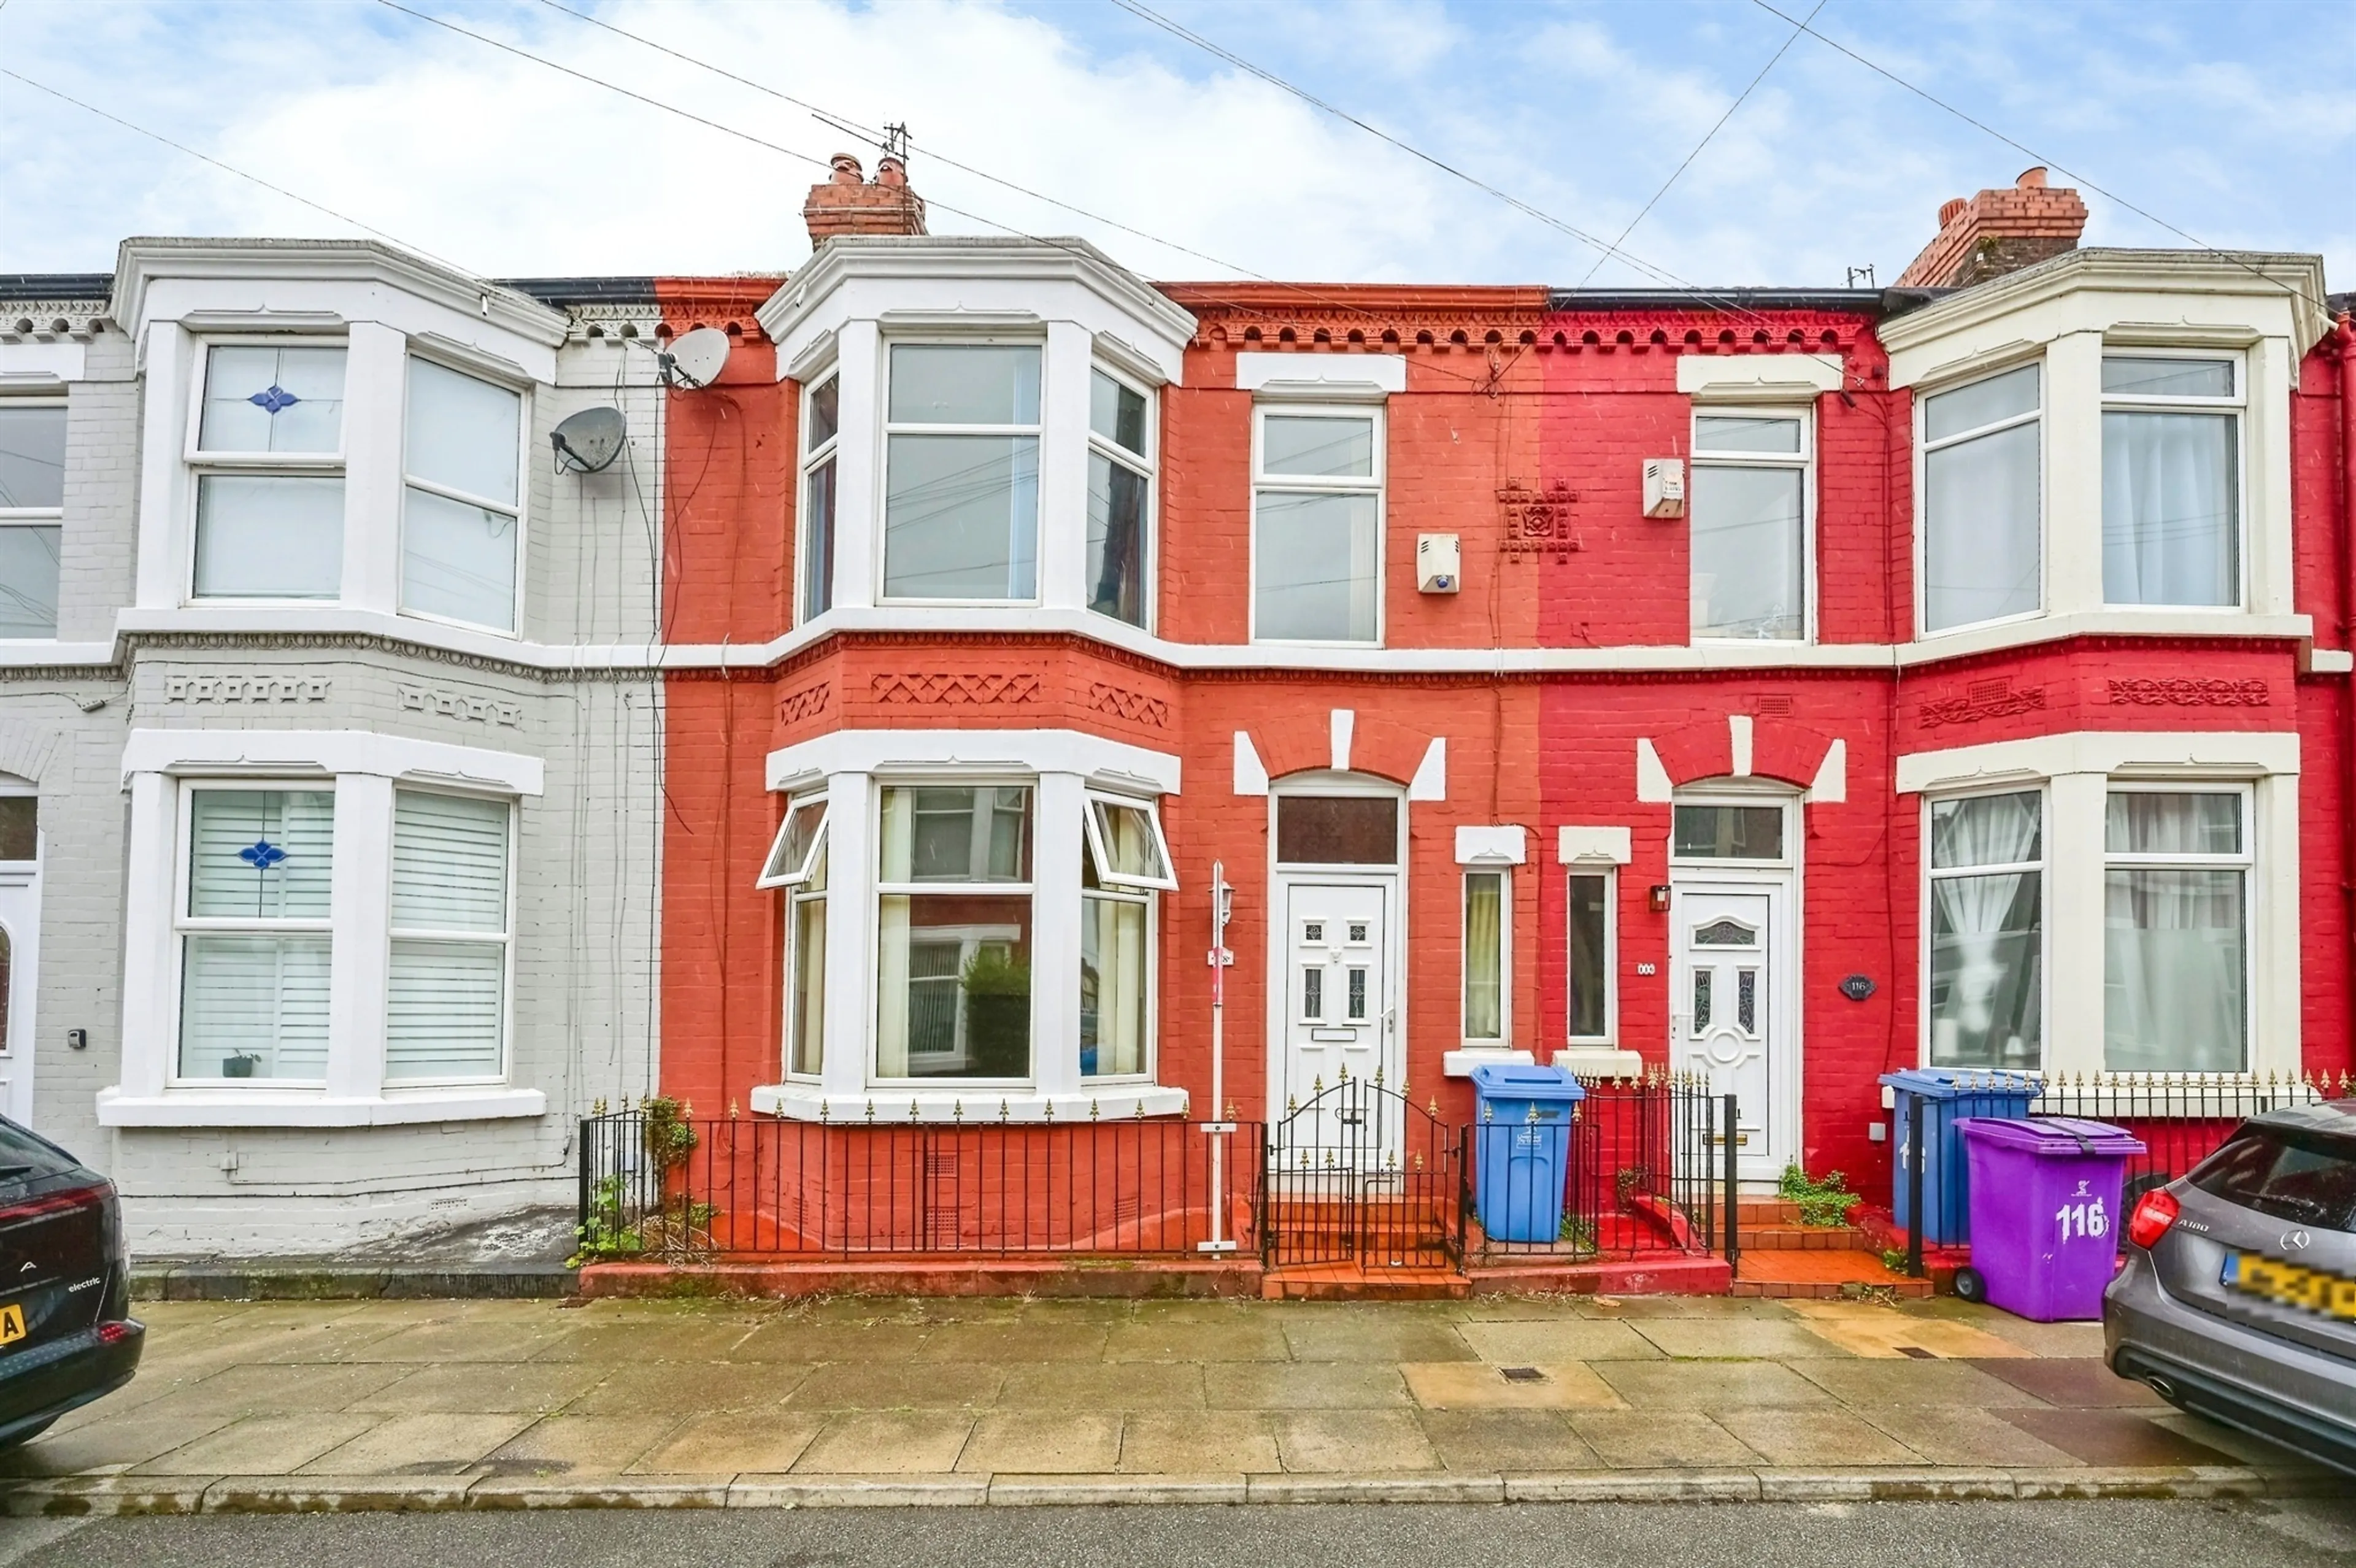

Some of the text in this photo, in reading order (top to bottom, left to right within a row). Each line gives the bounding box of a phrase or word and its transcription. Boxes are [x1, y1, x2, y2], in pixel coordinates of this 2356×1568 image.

[1852, 982, 1866, 991] 116
[2056, 1201, 2108, 1240] 116
[68, 1277, 101, 1293] electric
[4, 1312, 19, 1338] A
